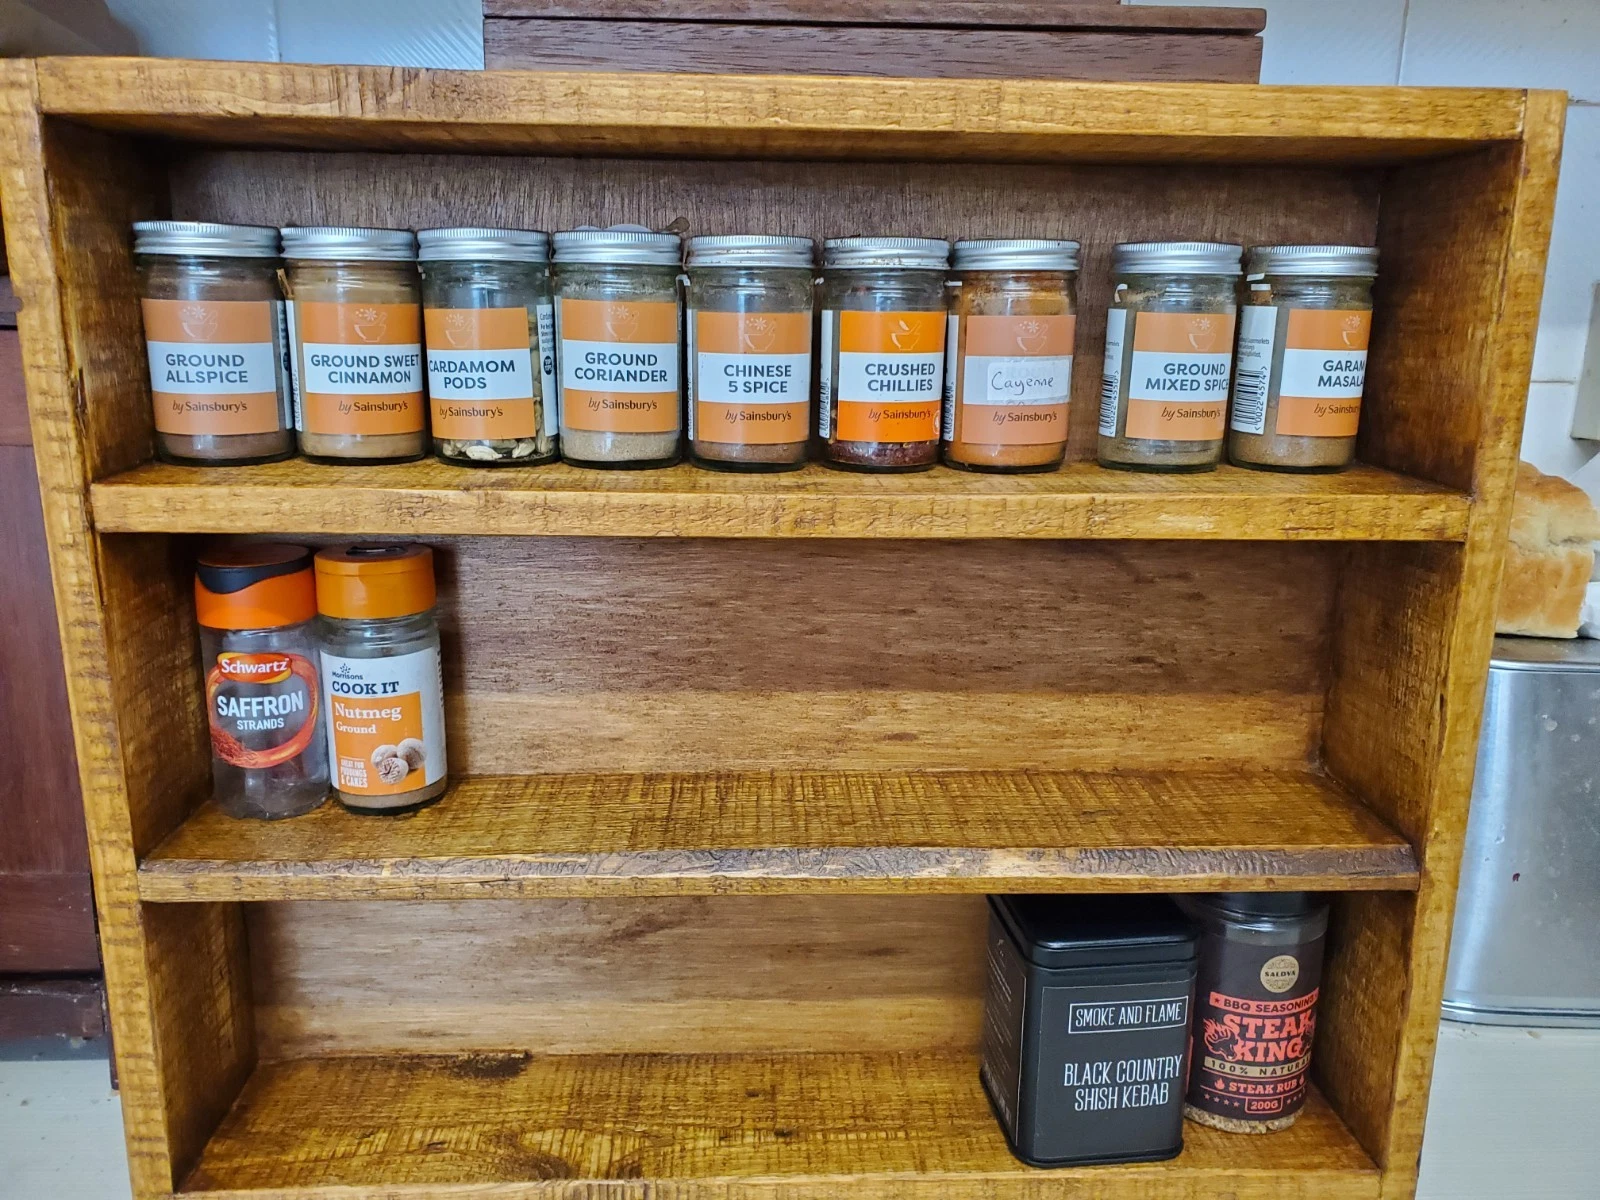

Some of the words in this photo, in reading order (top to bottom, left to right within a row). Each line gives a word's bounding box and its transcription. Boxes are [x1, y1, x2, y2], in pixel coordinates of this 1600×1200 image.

[165, 353, 245, 367] GROUND
[311, 354, 380, 368] GROUND
[384, 354, 419, 367] SWEET
[585, 352, 658, 366] GROUND
[429, 360, 516, 373] CARDAMOM
[723, 364, 792, 377] CHINESE
[864, 363, 936, 376] CRUSHED
[1163, 362, 1226, 376] GROUND
[166, 370, 249, 383] ALLSPICE
[328, 370, 411, 383] CINNAMON
[574, 367, 668, 382] CORIANDER
[444, 377, 487, 389] PODS
[728, 381, 738, 393] 5
[743, 381, 788, 393] SPICE
[867, 379, 933, 392] CHILLIES
[991, 371, 1054, 396] Cayenne
[1145, 377, 1201, 391] MIXED
[172, 400, 184, 414] by
[185, 401, 248, 413] Sainsbury's
[338, 401, 352, 415] by
[353, 401, 409, 412] Sainsbury's
[588, 397, 600, 412] by
[602, 399, 658, 411] Sainsbury's
[1313, 402, 1327, 417] by
[440, 405, 448, 419] by
[448, 407, 504, 418] Sainsbury's
[725, 409, 738, 424] by
[739, 410, 792, 422] Sainsbury's
[868, 408, 881, 422] by
[883, 409, 931, 420] Sainsbury's
[992, 411, 1006, 425] by
[1007, 411, 1058, 423] Sainsbury's
[1161, 406, 1175, 421] by
[1176, 408, 1221, 419] Sainsbury's
[221, 658, 288, 673] Schwartz
[332, 671, 364, 680] Morrisons
[332, 680, 378, 695] COOK
[381, 681, 400, 694] IT
[217, 690, 304, 717] SAFFRON
[334, 701, 402, 721] Nutmeg
[236, 718, 285, 730] STRANDS
[336, 721, 377, 734] Ground
[1223, 998, 1250, 1011] BBQ
[1255, 994, 1315, 1013] SEASONING
[1075, 1007, 1115, 1027] SMOKE
[1118, 1005, 1143, 1025] AND
[1145, 1002, 1183, 1023] FLAME
[1223, 1009, 1312, 1039] STEAK
[1233, 1037, 1302, 1062] KING
[1064, 1061, 1112, 1086] BLACK
[1116, 1054, 1183, 1083] COUNTRY
[1211, 1060, 1248, 1075] 100%
[1229, 1081, 1274, 1094] STEAK
[1277, 1079, 1298, 1092] RUB
[1074, 1086, 1118, 1111] SHISH
[1121, 1082, 1169, 1108] KEBAB
[1250, 1100, 1278, 1110] 200G
